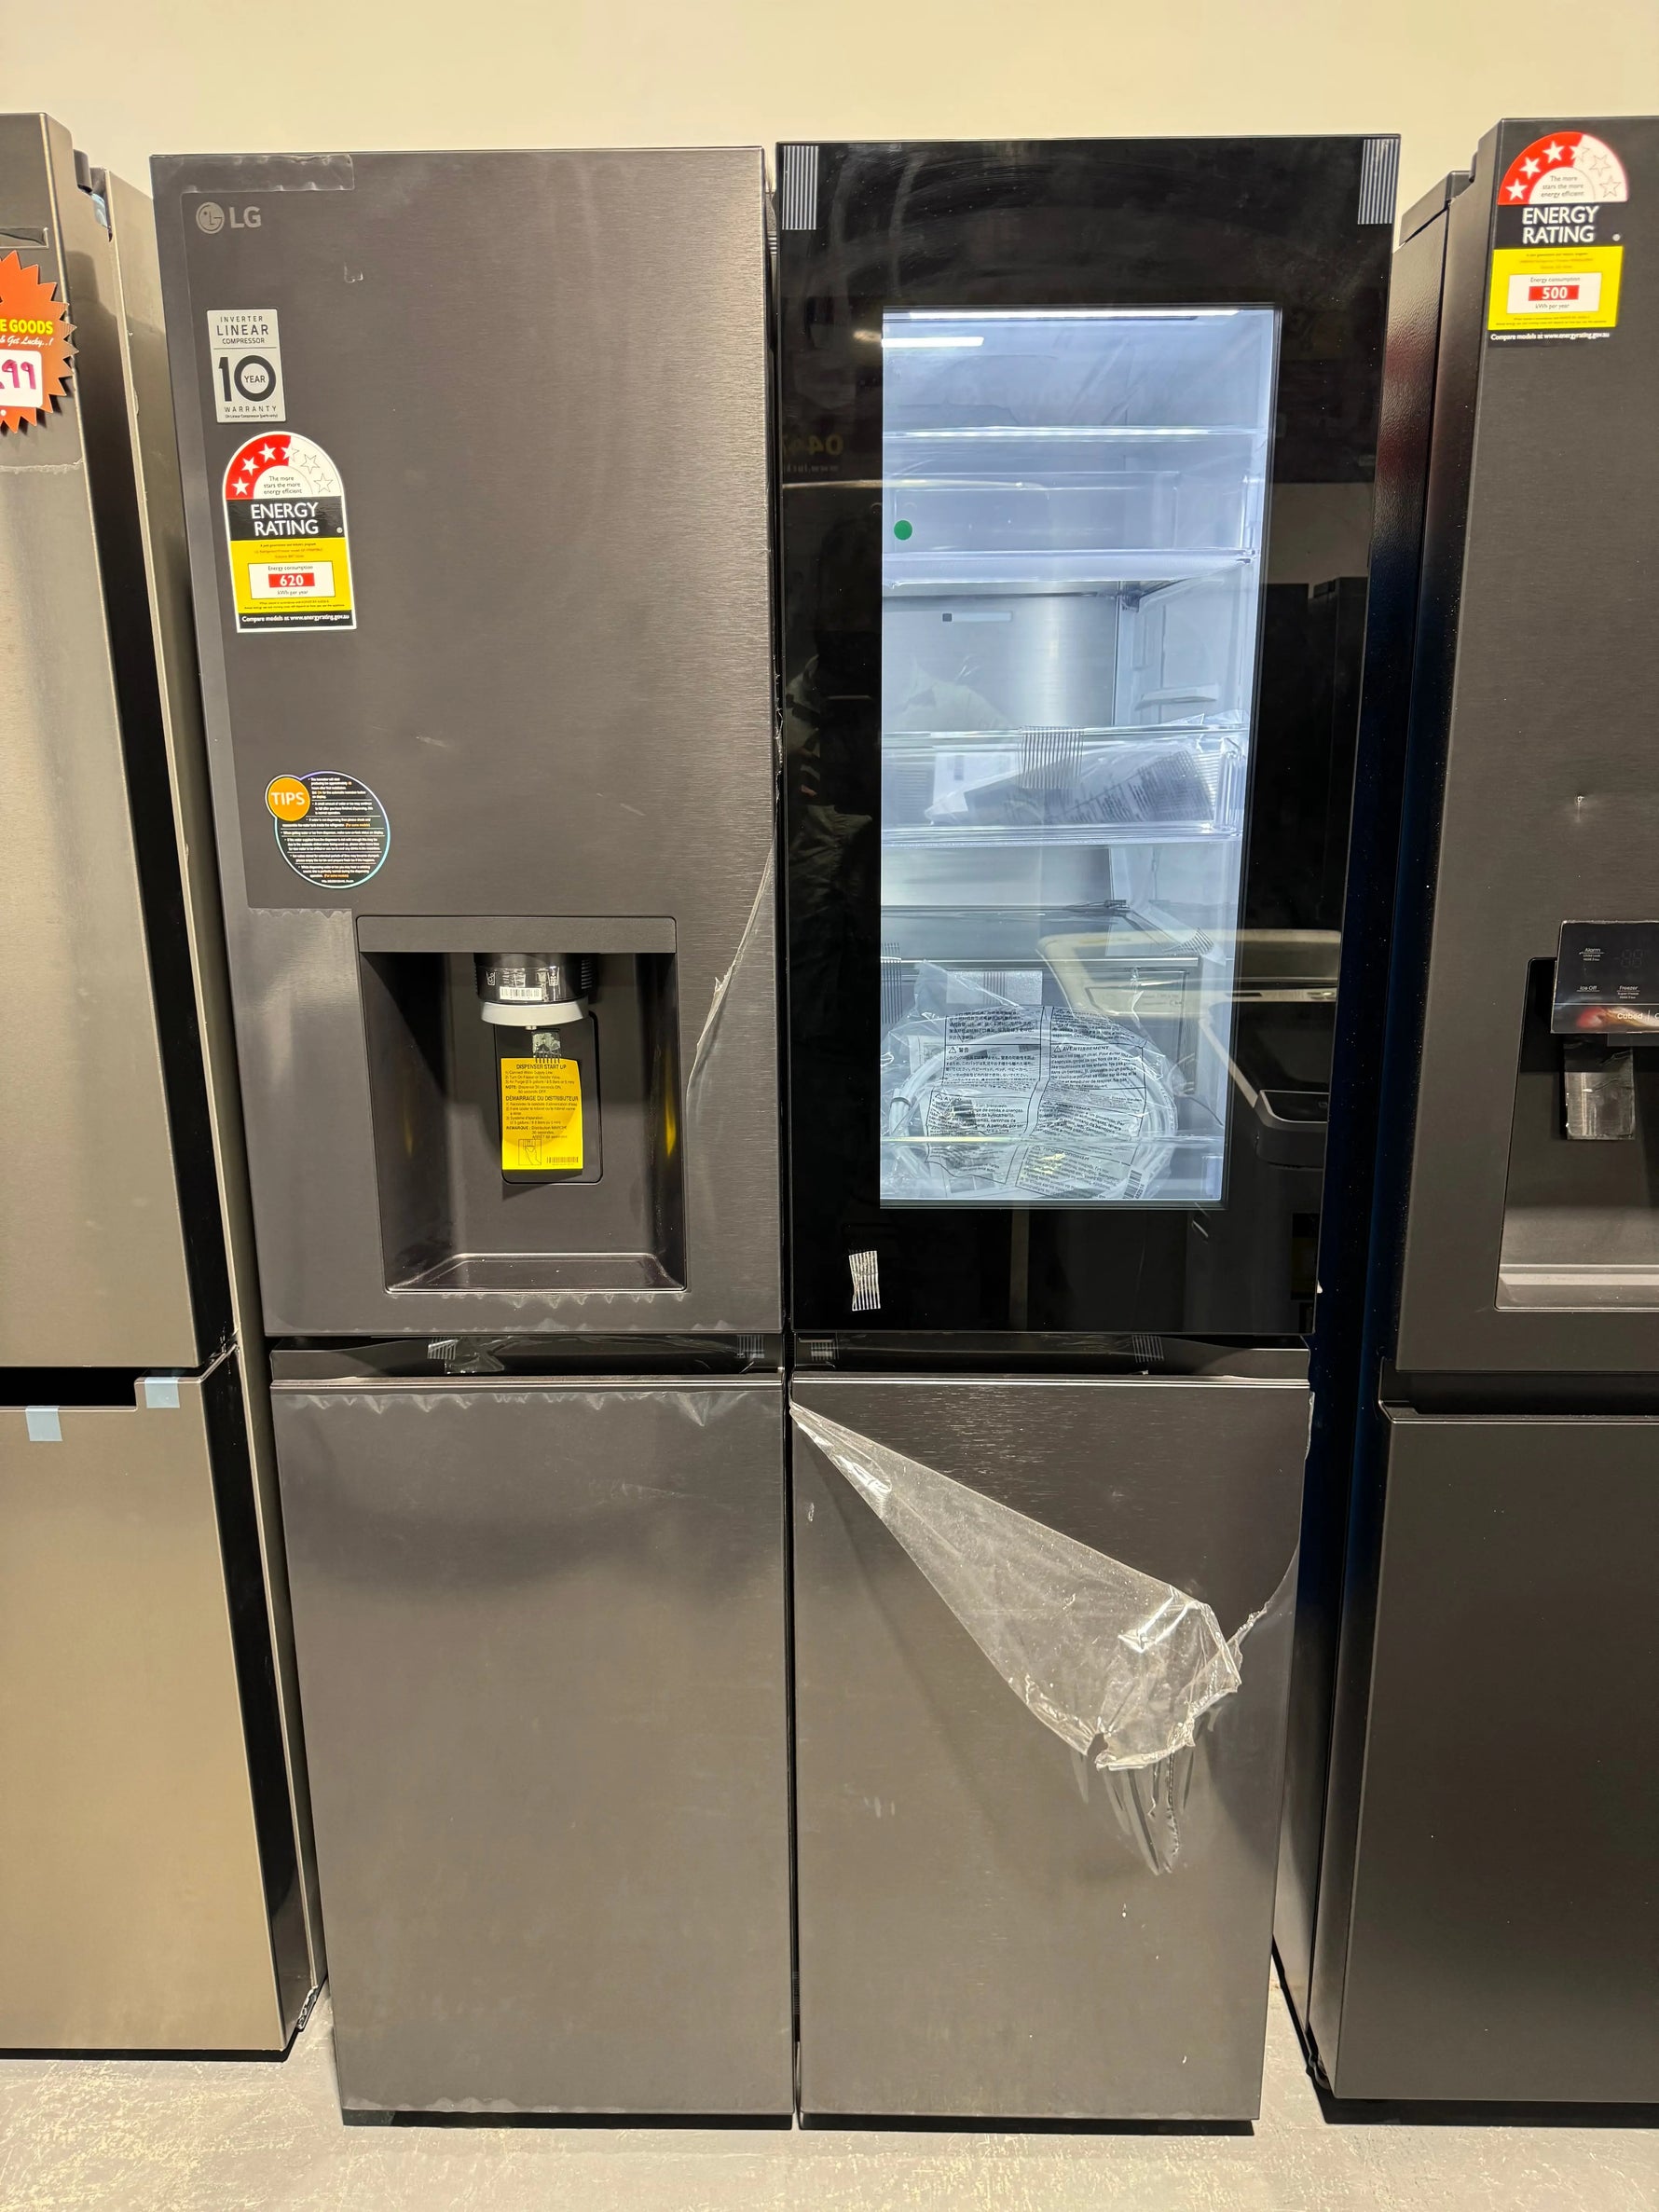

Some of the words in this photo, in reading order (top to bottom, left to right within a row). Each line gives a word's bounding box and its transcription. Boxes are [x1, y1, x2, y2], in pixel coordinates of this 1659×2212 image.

[229, 206, 262, 228] LG
[1522, 205, 1599, 225] ENERGY
[1523, 226, 1595, 244] RATING
[1542, 287, 1568, 299] 500
[8, 319, 54, 335] GOODS
[216, 324, 268, 337] LINEAR
[218, 355, 277, 403] 10
[244, 375, 266, 383] YEAR
[251, 502, 319, 519] ENERGY
[254, 519, 319, 536] RATING
[280, 574, 304, 586] 620
[271, 791, 306, 805] TIPS
